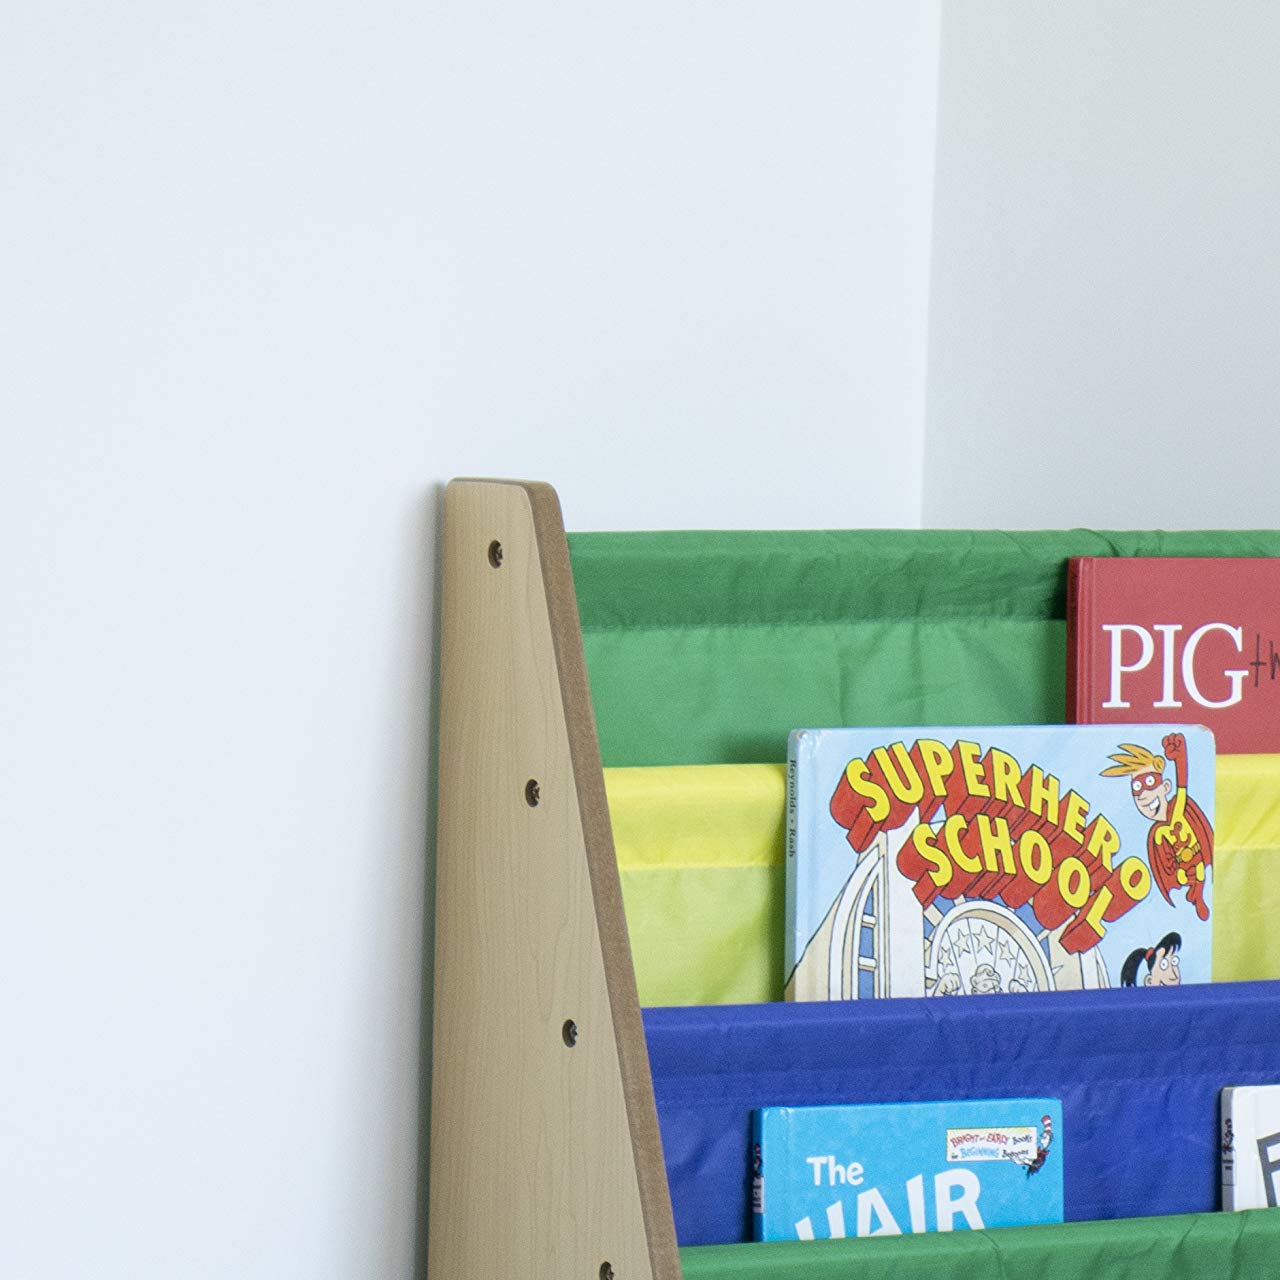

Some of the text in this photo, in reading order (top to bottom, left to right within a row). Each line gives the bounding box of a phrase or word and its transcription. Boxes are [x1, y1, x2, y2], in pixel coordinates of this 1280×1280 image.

[1102, 622, 1249, 709] PIG
[832, 738, 1151, 902] SUPERHERO
[902, 813, 1114, 944] SCHOOL
[806, 1155, 864, 1186] The
